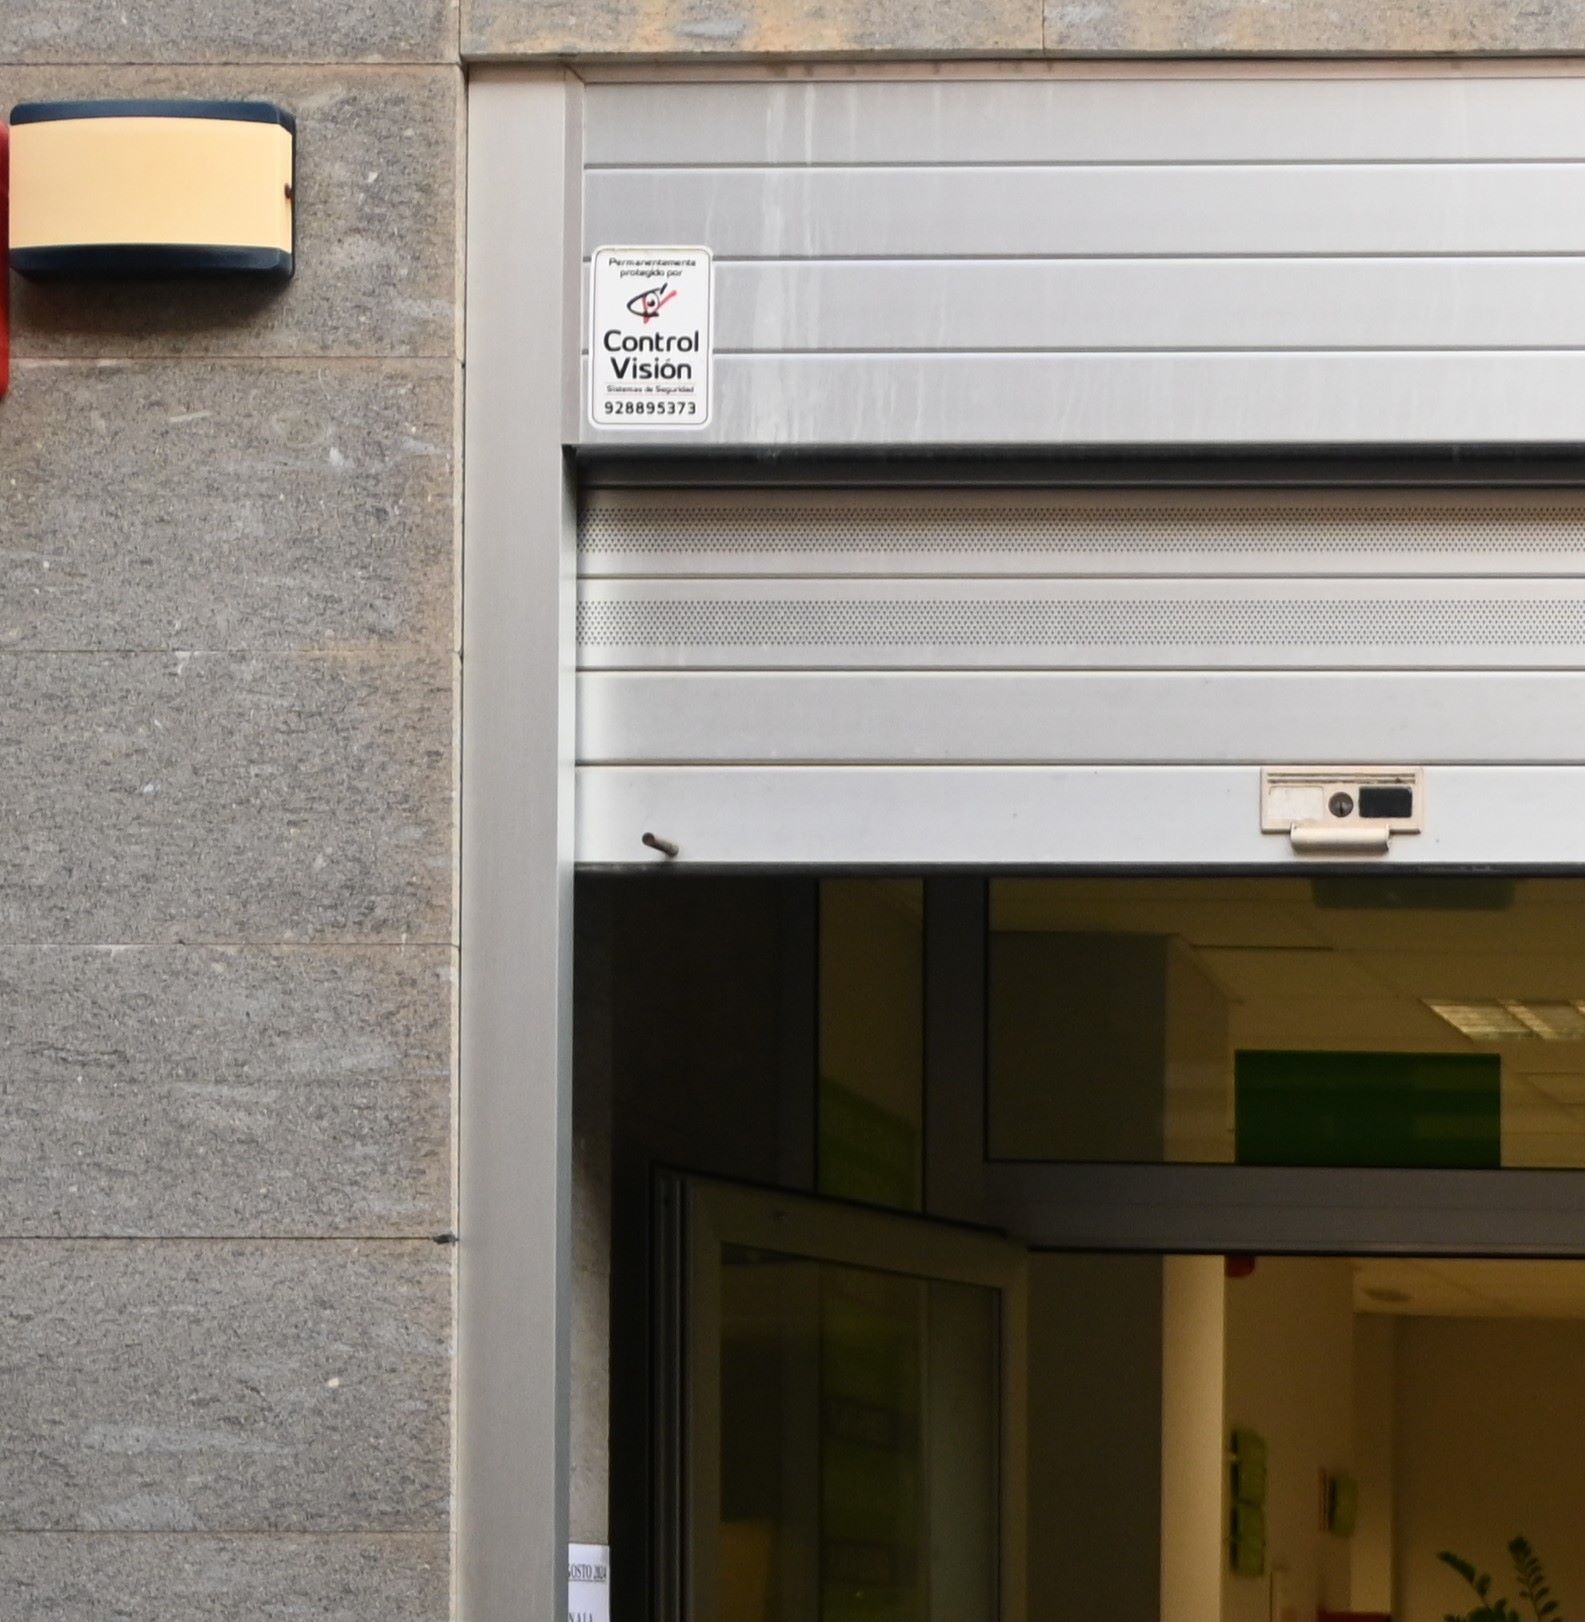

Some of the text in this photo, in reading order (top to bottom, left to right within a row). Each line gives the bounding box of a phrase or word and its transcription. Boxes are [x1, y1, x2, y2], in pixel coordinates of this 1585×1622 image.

[620, 268, 683, 278] protegido por
[603, 329, 699, 352] Control
[610, 356, 692, 380] Visión
[644, 385, 653, 393] de
[655, 384, 695, 395] Seguridad
[604, 401, 697, 415] 928895373
[568, 1563, 592, 1579] OSTO
